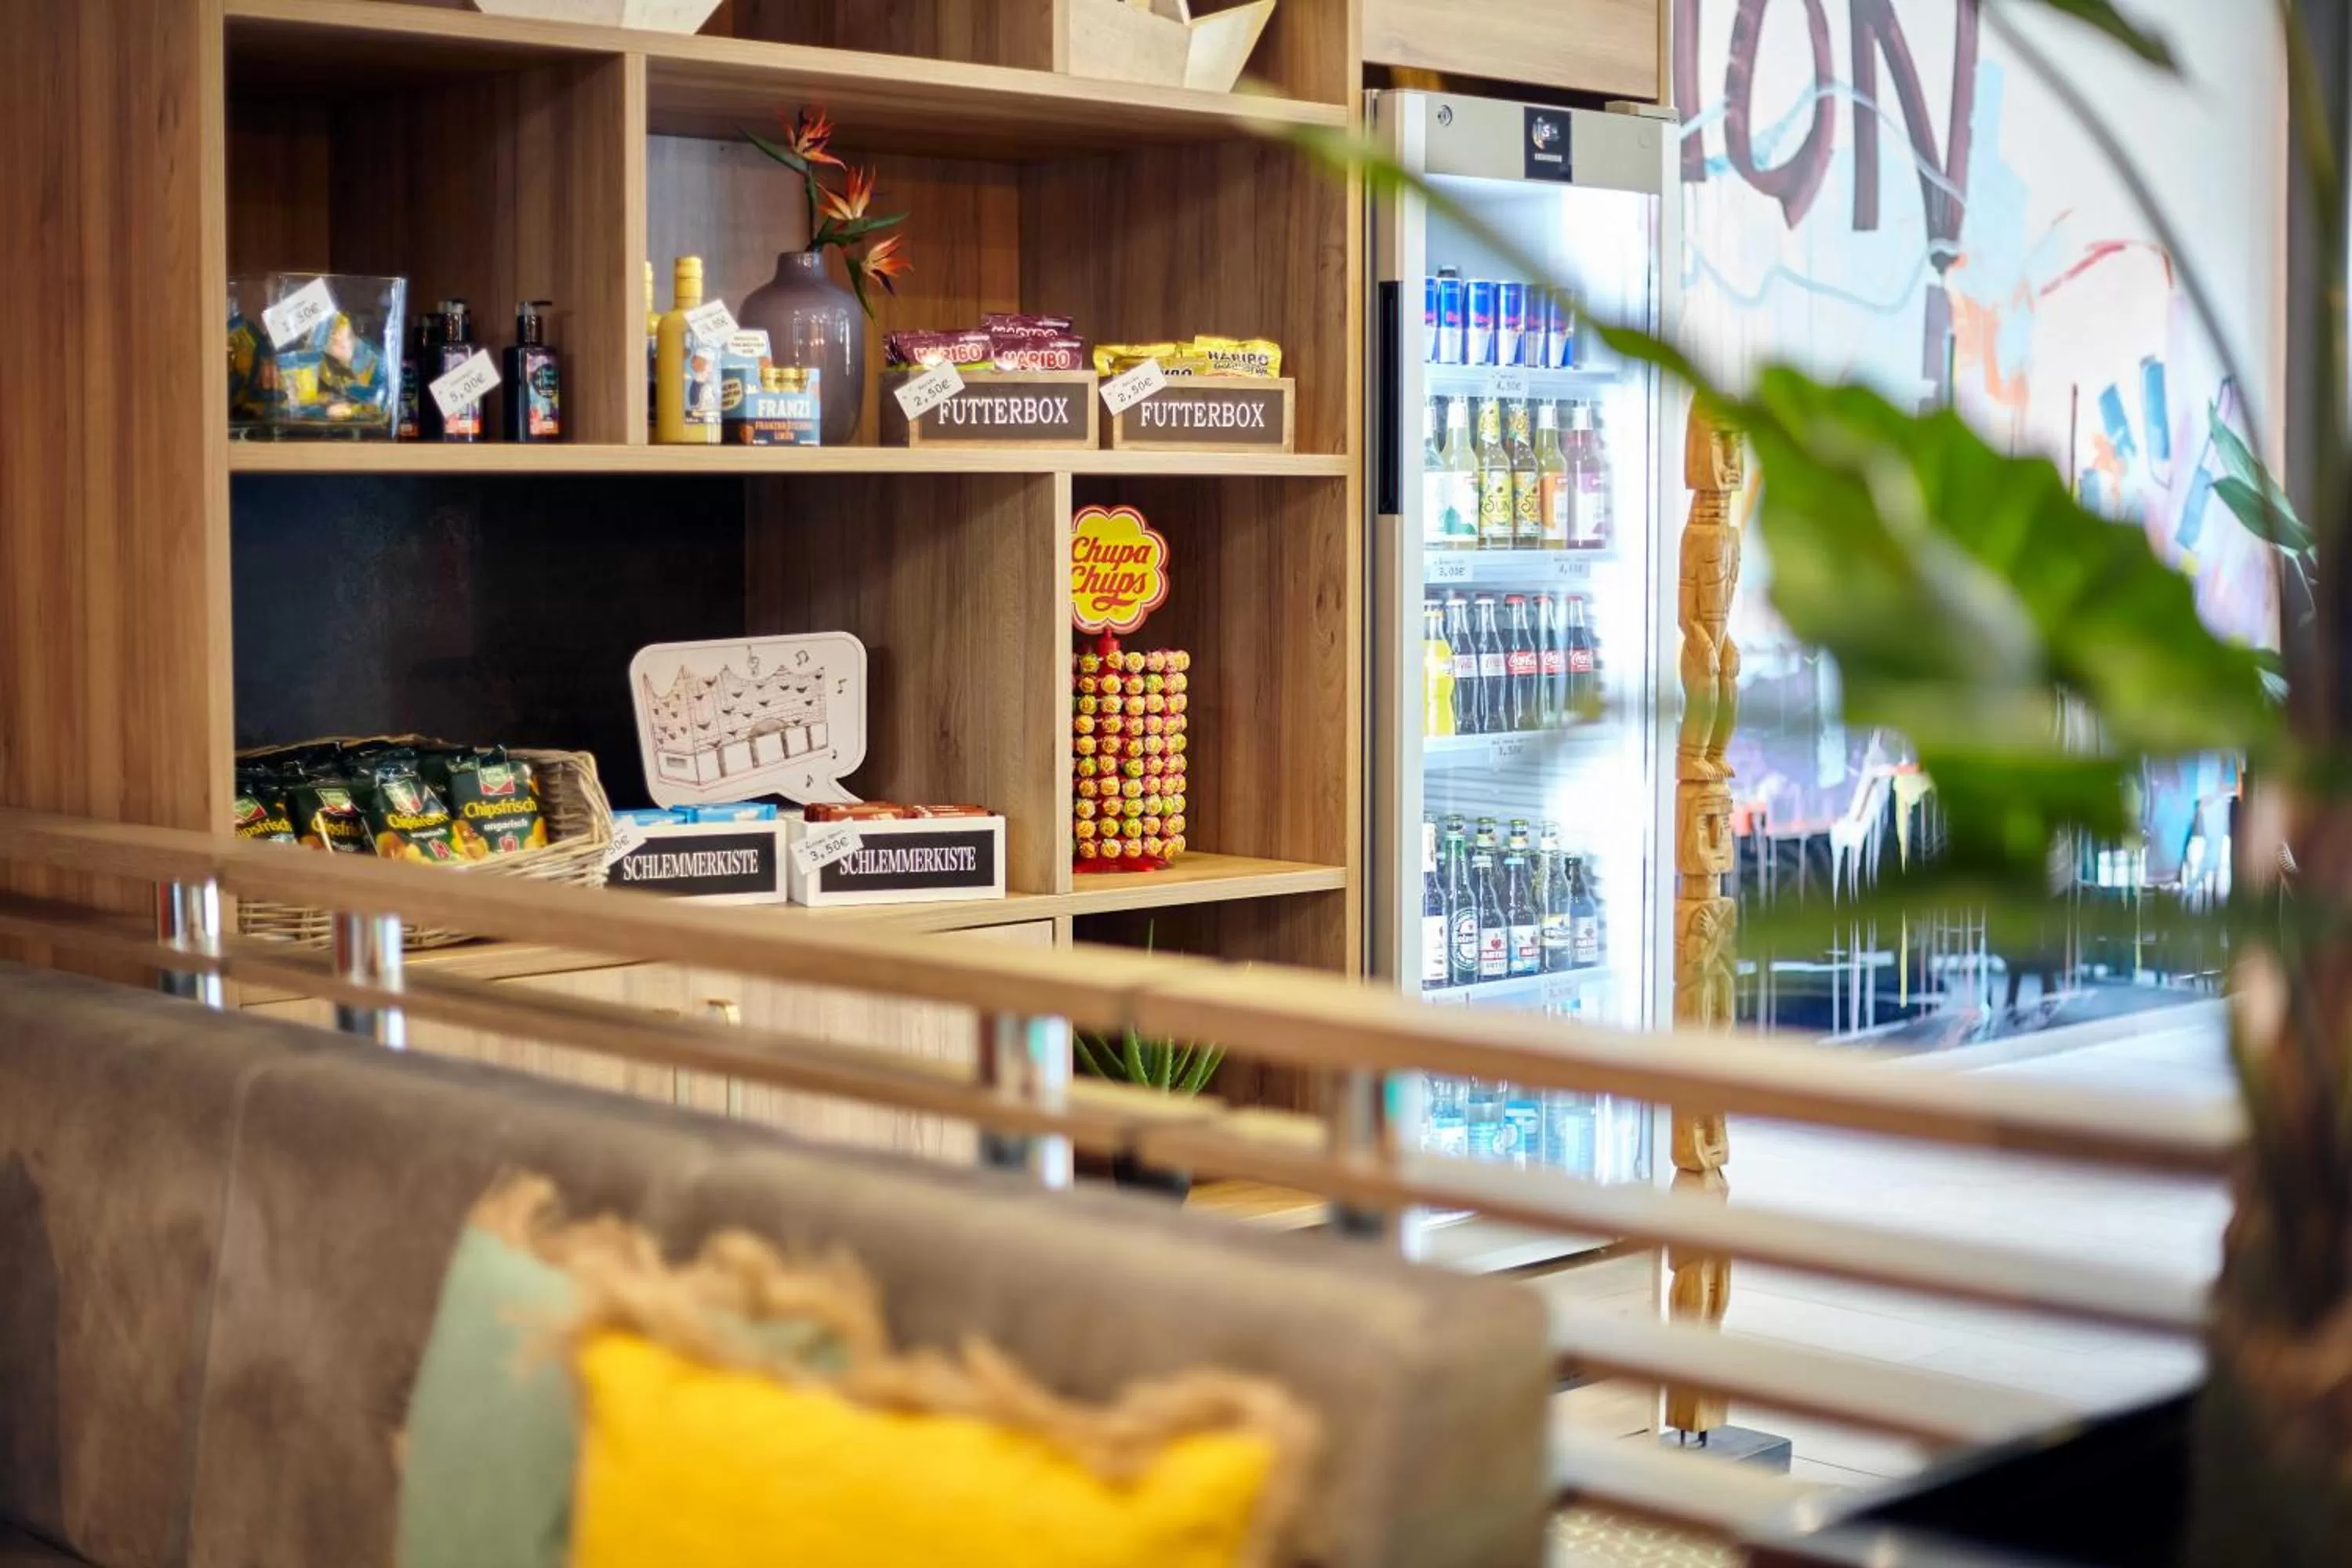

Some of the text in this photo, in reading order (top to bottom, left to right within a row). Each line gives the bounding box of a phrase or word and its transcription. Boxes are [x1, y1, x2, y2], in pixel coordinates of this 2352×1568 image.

[448, 372, 487, 402] 5,00€
[913, 377, 953, 407] 2,50€
[1117, 376, 1154, 403] 2,50€
[757, 397, 811, 418] FRANZI
[938, 397, 1069, 425] FUTTERBOX
[1140, 401, 1265, 428] FUTTERBOX
[1072, 535, 1152, 572] Chupa
[1071, 564, 1149, 612] Chups
[464, 797, 538, 819] Chipsfrisch
[810, 837, 848, 862] 3,50€
[840, 846, 976, 876] SCHLEMMERKISTE
[623, 848, 759, 881] SCHLEMMERKISTE
